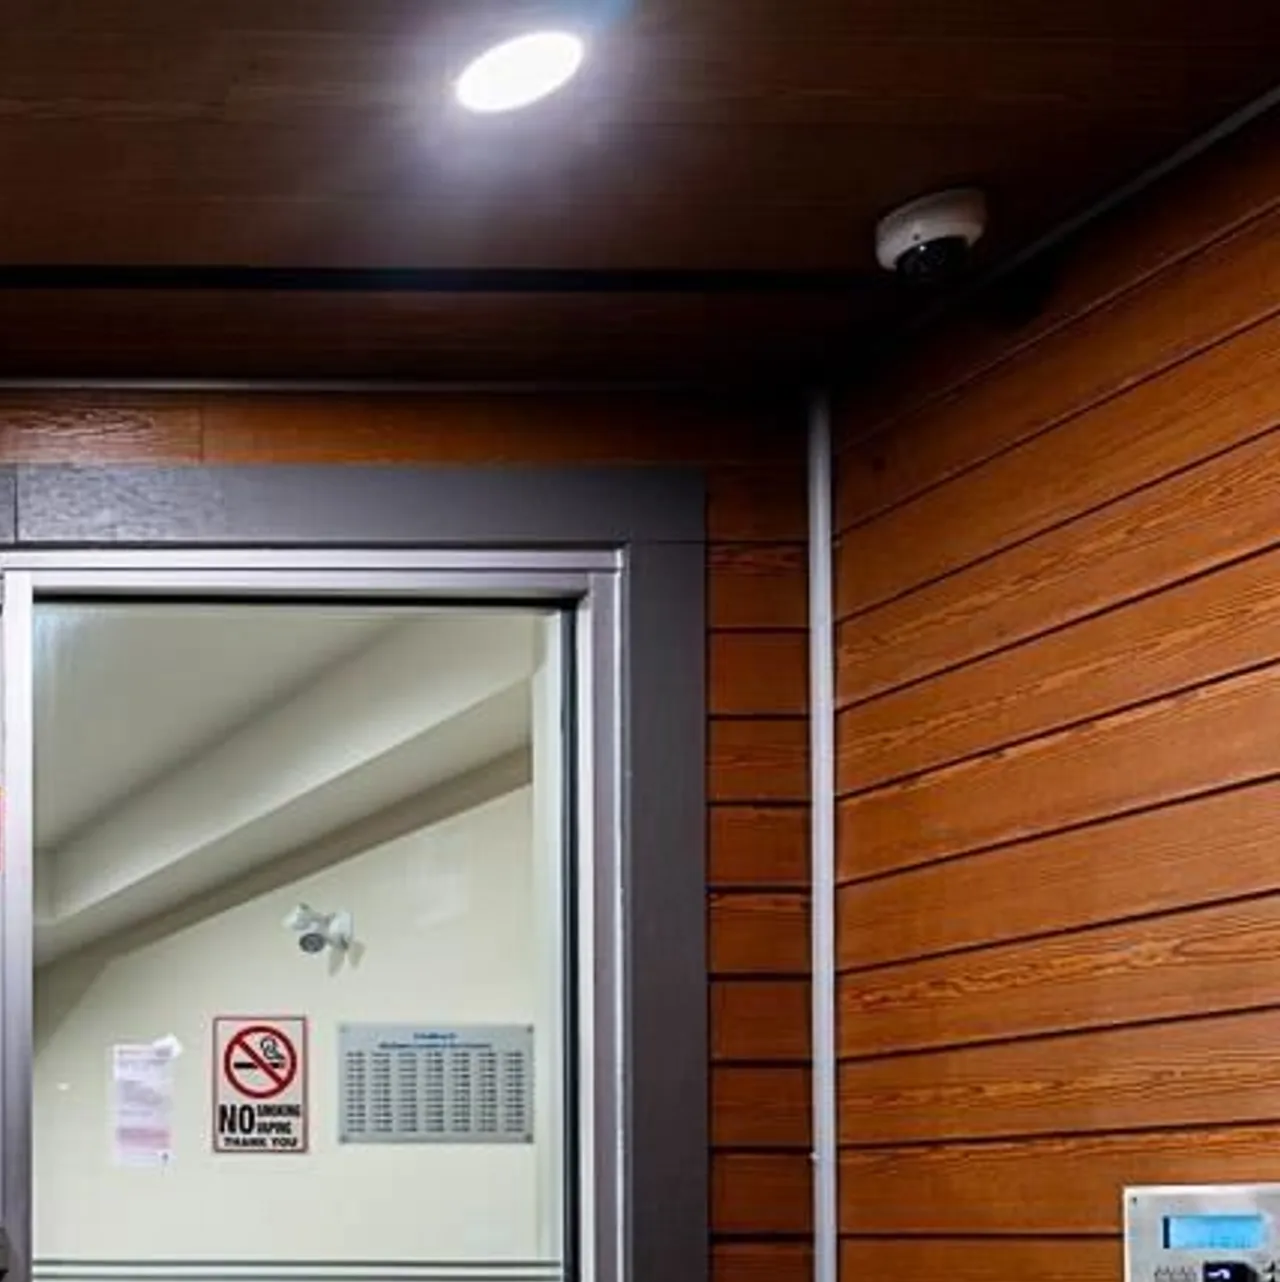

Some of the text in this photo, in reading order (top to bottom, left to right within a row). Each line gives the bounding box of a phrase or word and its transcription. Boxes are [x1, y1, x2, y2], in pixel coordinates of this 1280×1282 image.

[257, 1103, 301, 1117] SMOKING
[218, 1104, 256, 1135] NO
[257, 1121, 292, 1135] VAPING
[223, 1136, 298, 1148] THANK YOU
